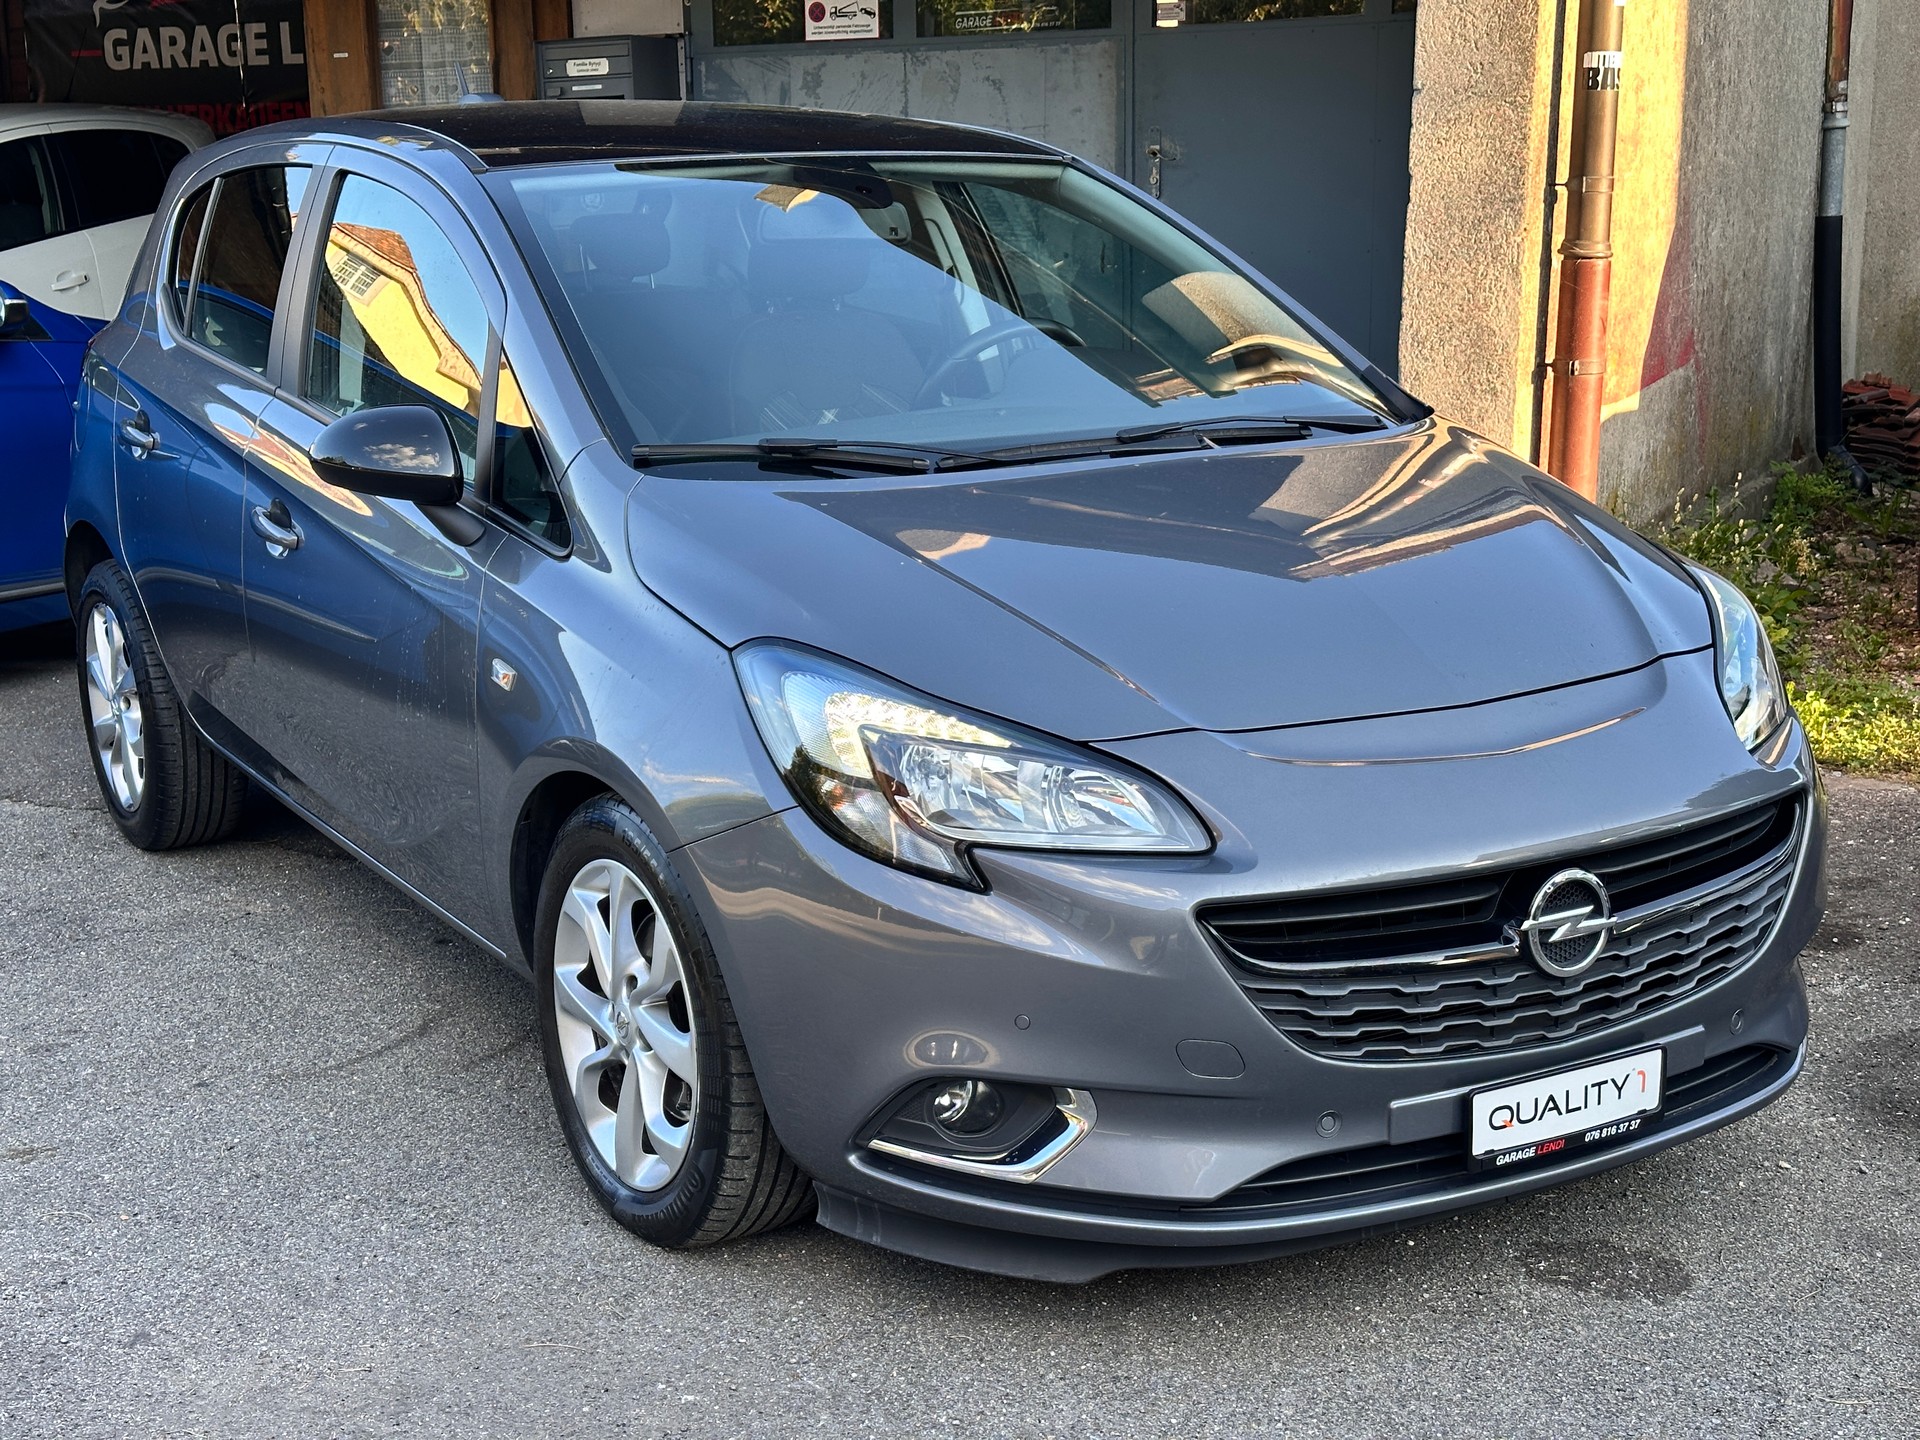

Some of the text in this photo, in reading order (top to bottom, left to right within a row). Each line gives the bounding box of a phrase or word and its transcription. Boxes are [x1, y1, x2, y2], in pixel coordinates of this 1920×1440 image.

[955, 15, 993, 29] GARAGE
[103, 22, 270, 71] GARAGE
[1496, 1119, 1642, 1166] GARAGE LENDI 076 816 37 37
